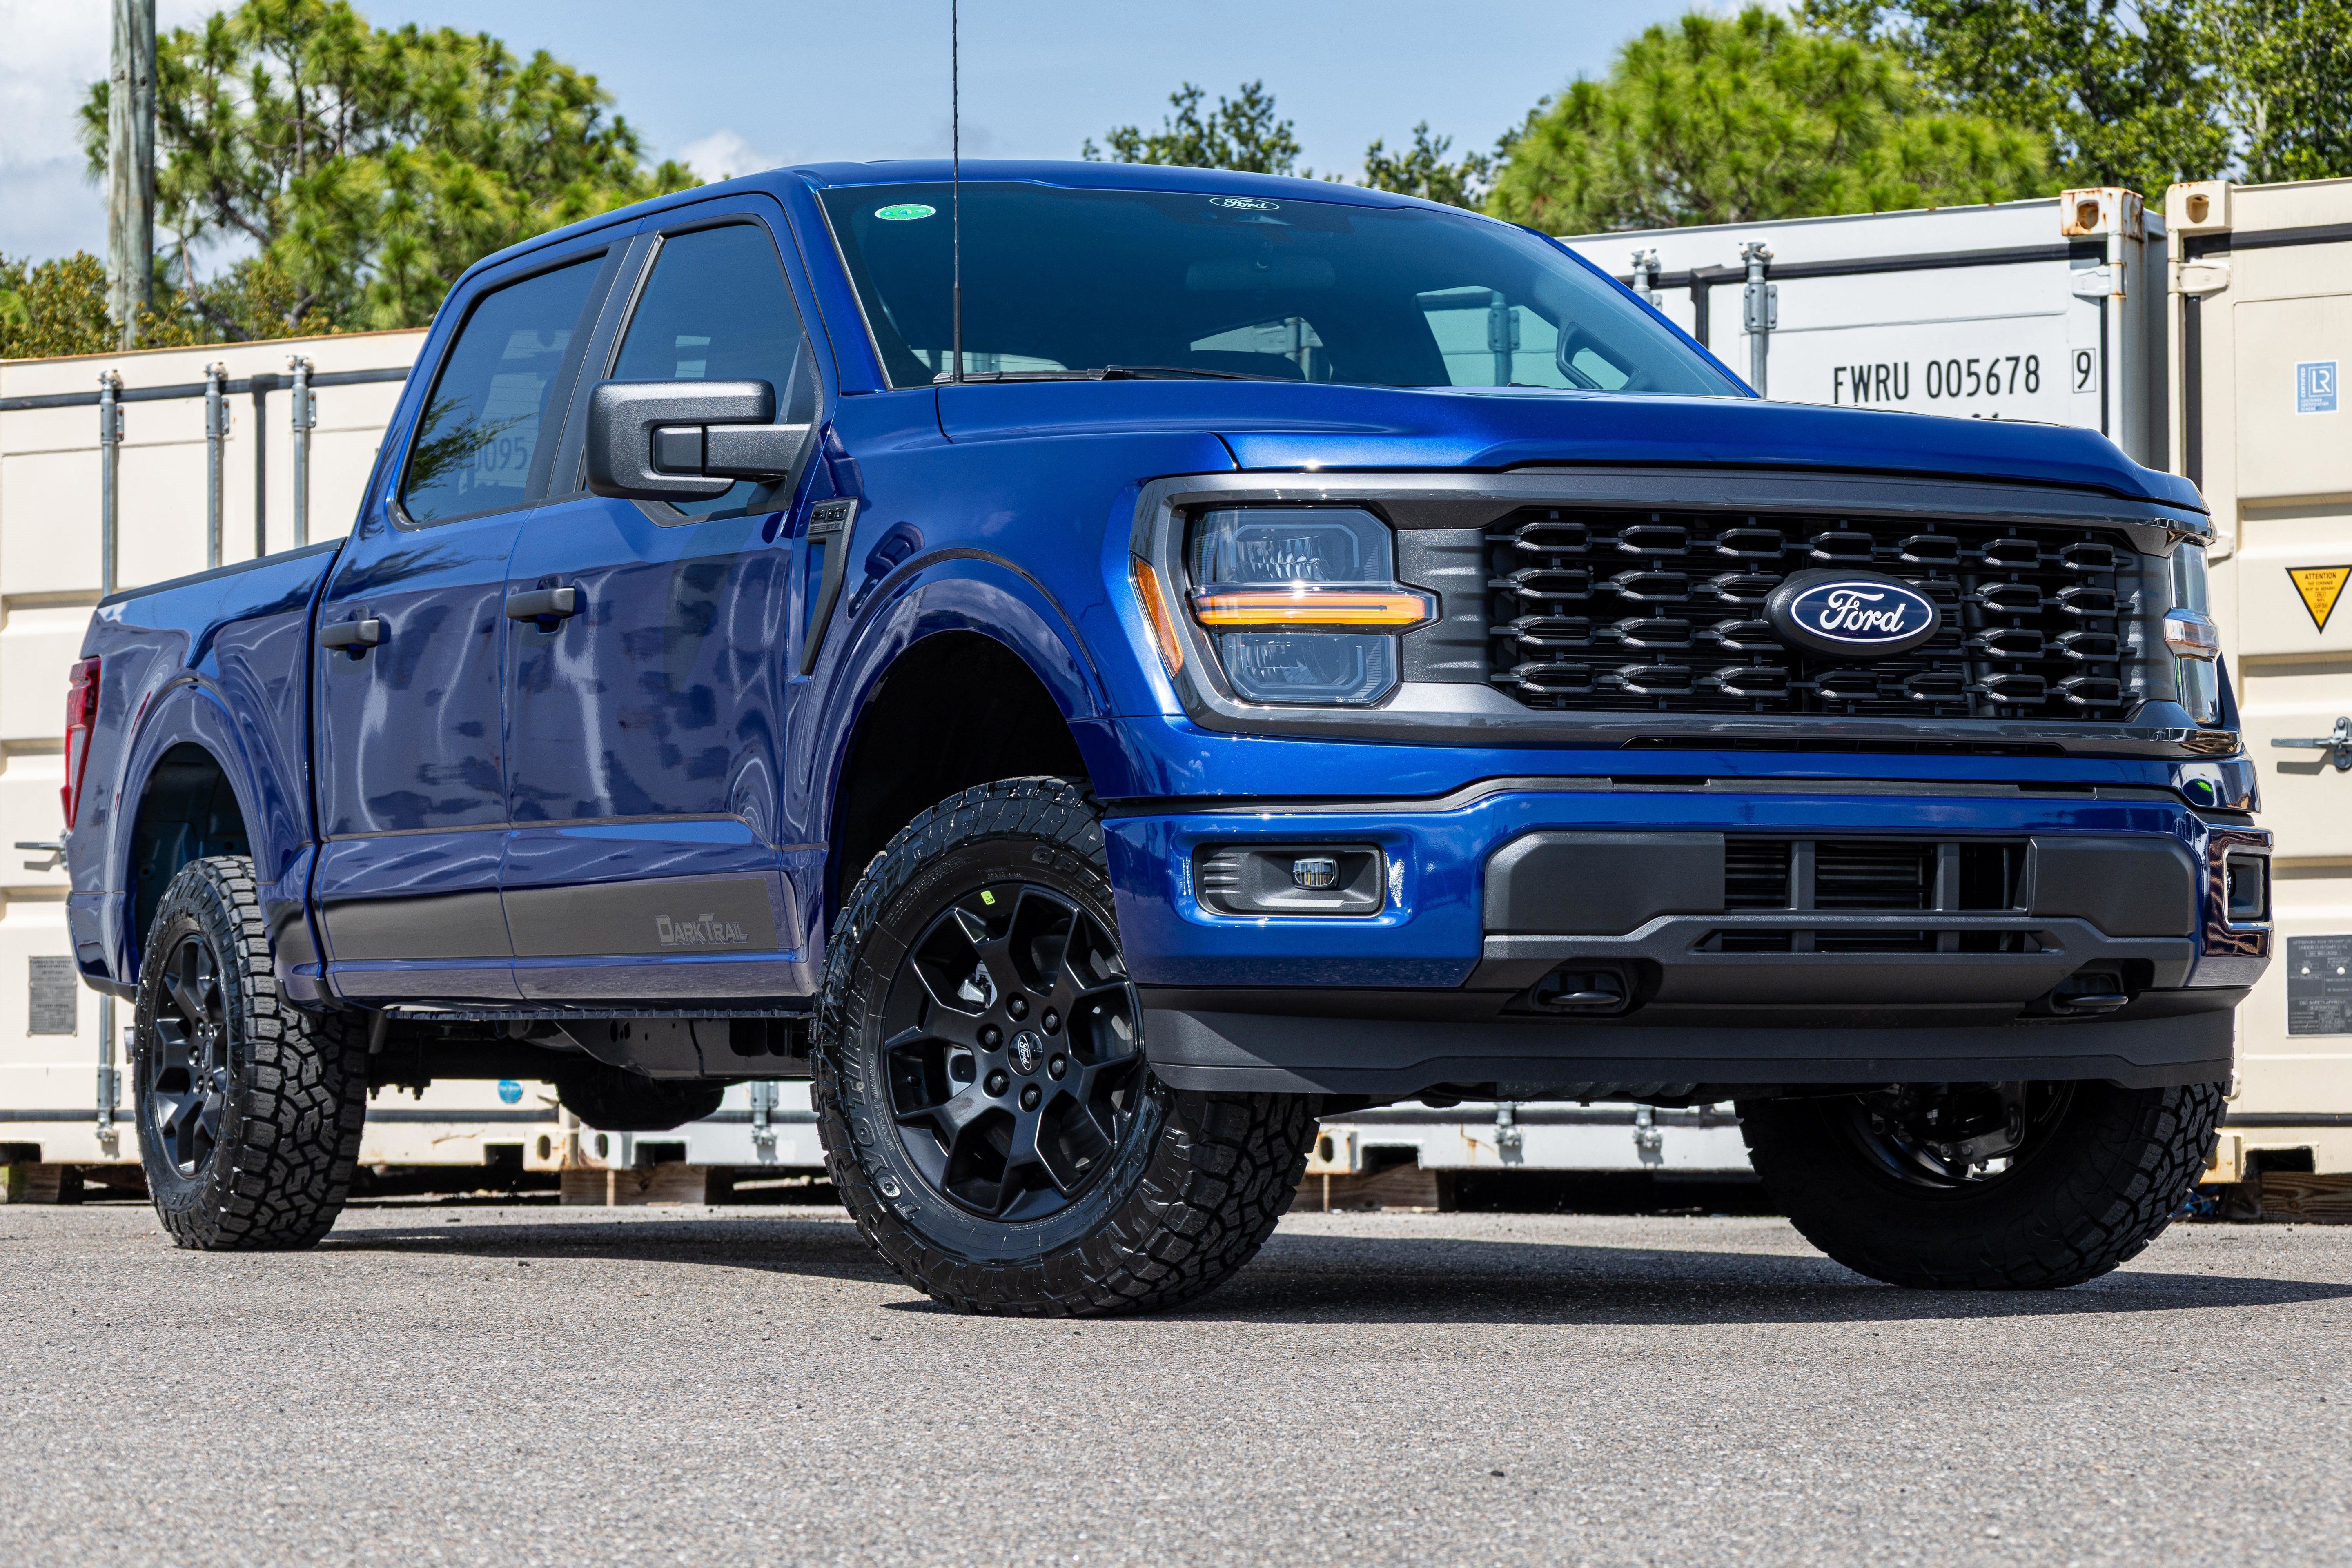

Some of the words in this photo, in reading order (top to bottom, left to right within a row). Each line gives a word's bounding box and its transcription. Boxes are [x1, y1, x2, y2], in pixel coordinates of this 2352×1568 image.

[1223, 198, 1268, 209] Ford
[1833, 361, 1909, 404] FWRU
[1926, 354, 2040, 399] 005678
[2076, 351, 2092, 390] 9
[2312, 370, 2331, 393] LR
[1820, 590, 1906, 632] Ford
[842, 957, 873, 1109] TIRES
[1019, 1041, 1030, 1065] Ford
[851, 1117, 921, 1222] TOYO
